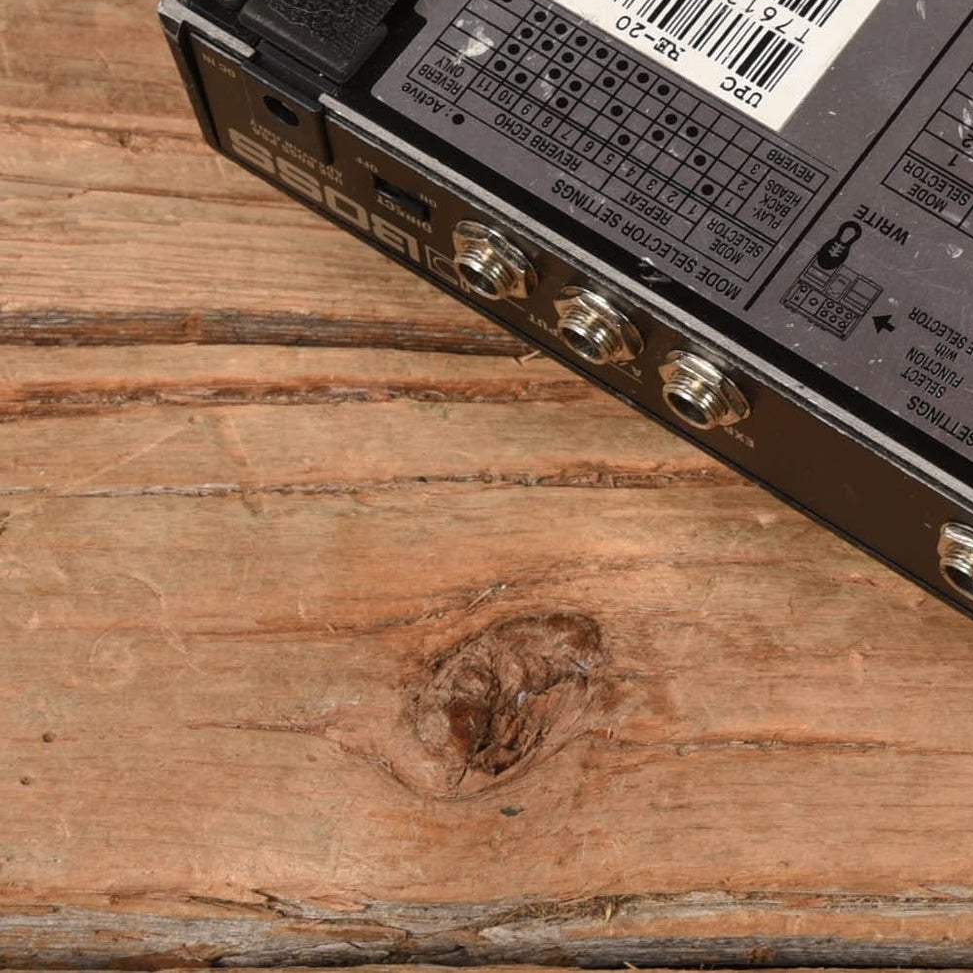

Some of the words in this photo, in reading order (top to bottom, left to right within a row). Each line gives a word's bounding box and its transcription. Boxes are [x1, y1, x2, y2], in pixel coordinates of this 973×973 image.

[614, 13, 687, 63] RE-20
[416, 62, 463, 97] REVERB
[432, 54, 466, 79] ONLY
[400, 80, 447, 114] Active
[474, 75, 494, 93] 11
[496, 88, 515, 106] 10
[718, 74, 763, 109] UPC
[519, 101, 534, 116] 9
[539, 114, 554, 129] 8
[492, 111, 532, 142] ECHO
[558, 127, 574, 141] 7
[528, 133, 583, 173] REVERB
[581, 139, 595, 154] 6
[601, 151, 616, 166] 5
[946, 152, 960, 168] 1
[623, 164, 637, 179] 4
[748, 161, 762, 176] 3
[764, 147, 817, 184] REVERB
[227, 128, 419, 262] BOSS
[644, 176, 659, 192] 3
[664, 188, 680, 204] 2
[735, 177, 750, 192] 2
[762, 177, 803, 208] HEADS
[901, 158, 972, 207] SELECTOR
[905, 181, 949, 214] MODE
[374, 192, 432, 235] DIRECT
[549, 177, 623, 229] SETTINGS
[619, 189, 674, 227] REPEAT
[685, 202, 698, 216] 1
[722, 195, 735, 209] 1
[758, 191, 792, 218] BACK
[751, 206, 783, 231] PLAY-
[851, 202, 910, 246] WRITE
[619, 219, 699, 274] SELECTOR
[705, 216, 765, 258] SELECTOR
[707, 236, 745, 266] MODE
[693, 264, 743, 301] MODE
[906, 305, 969, 350] SELECTOR
[903, 345, 965, 389] FUNCTION
[932, 340, 959, 363] with
[898, 364, 947, 400] SELECT
